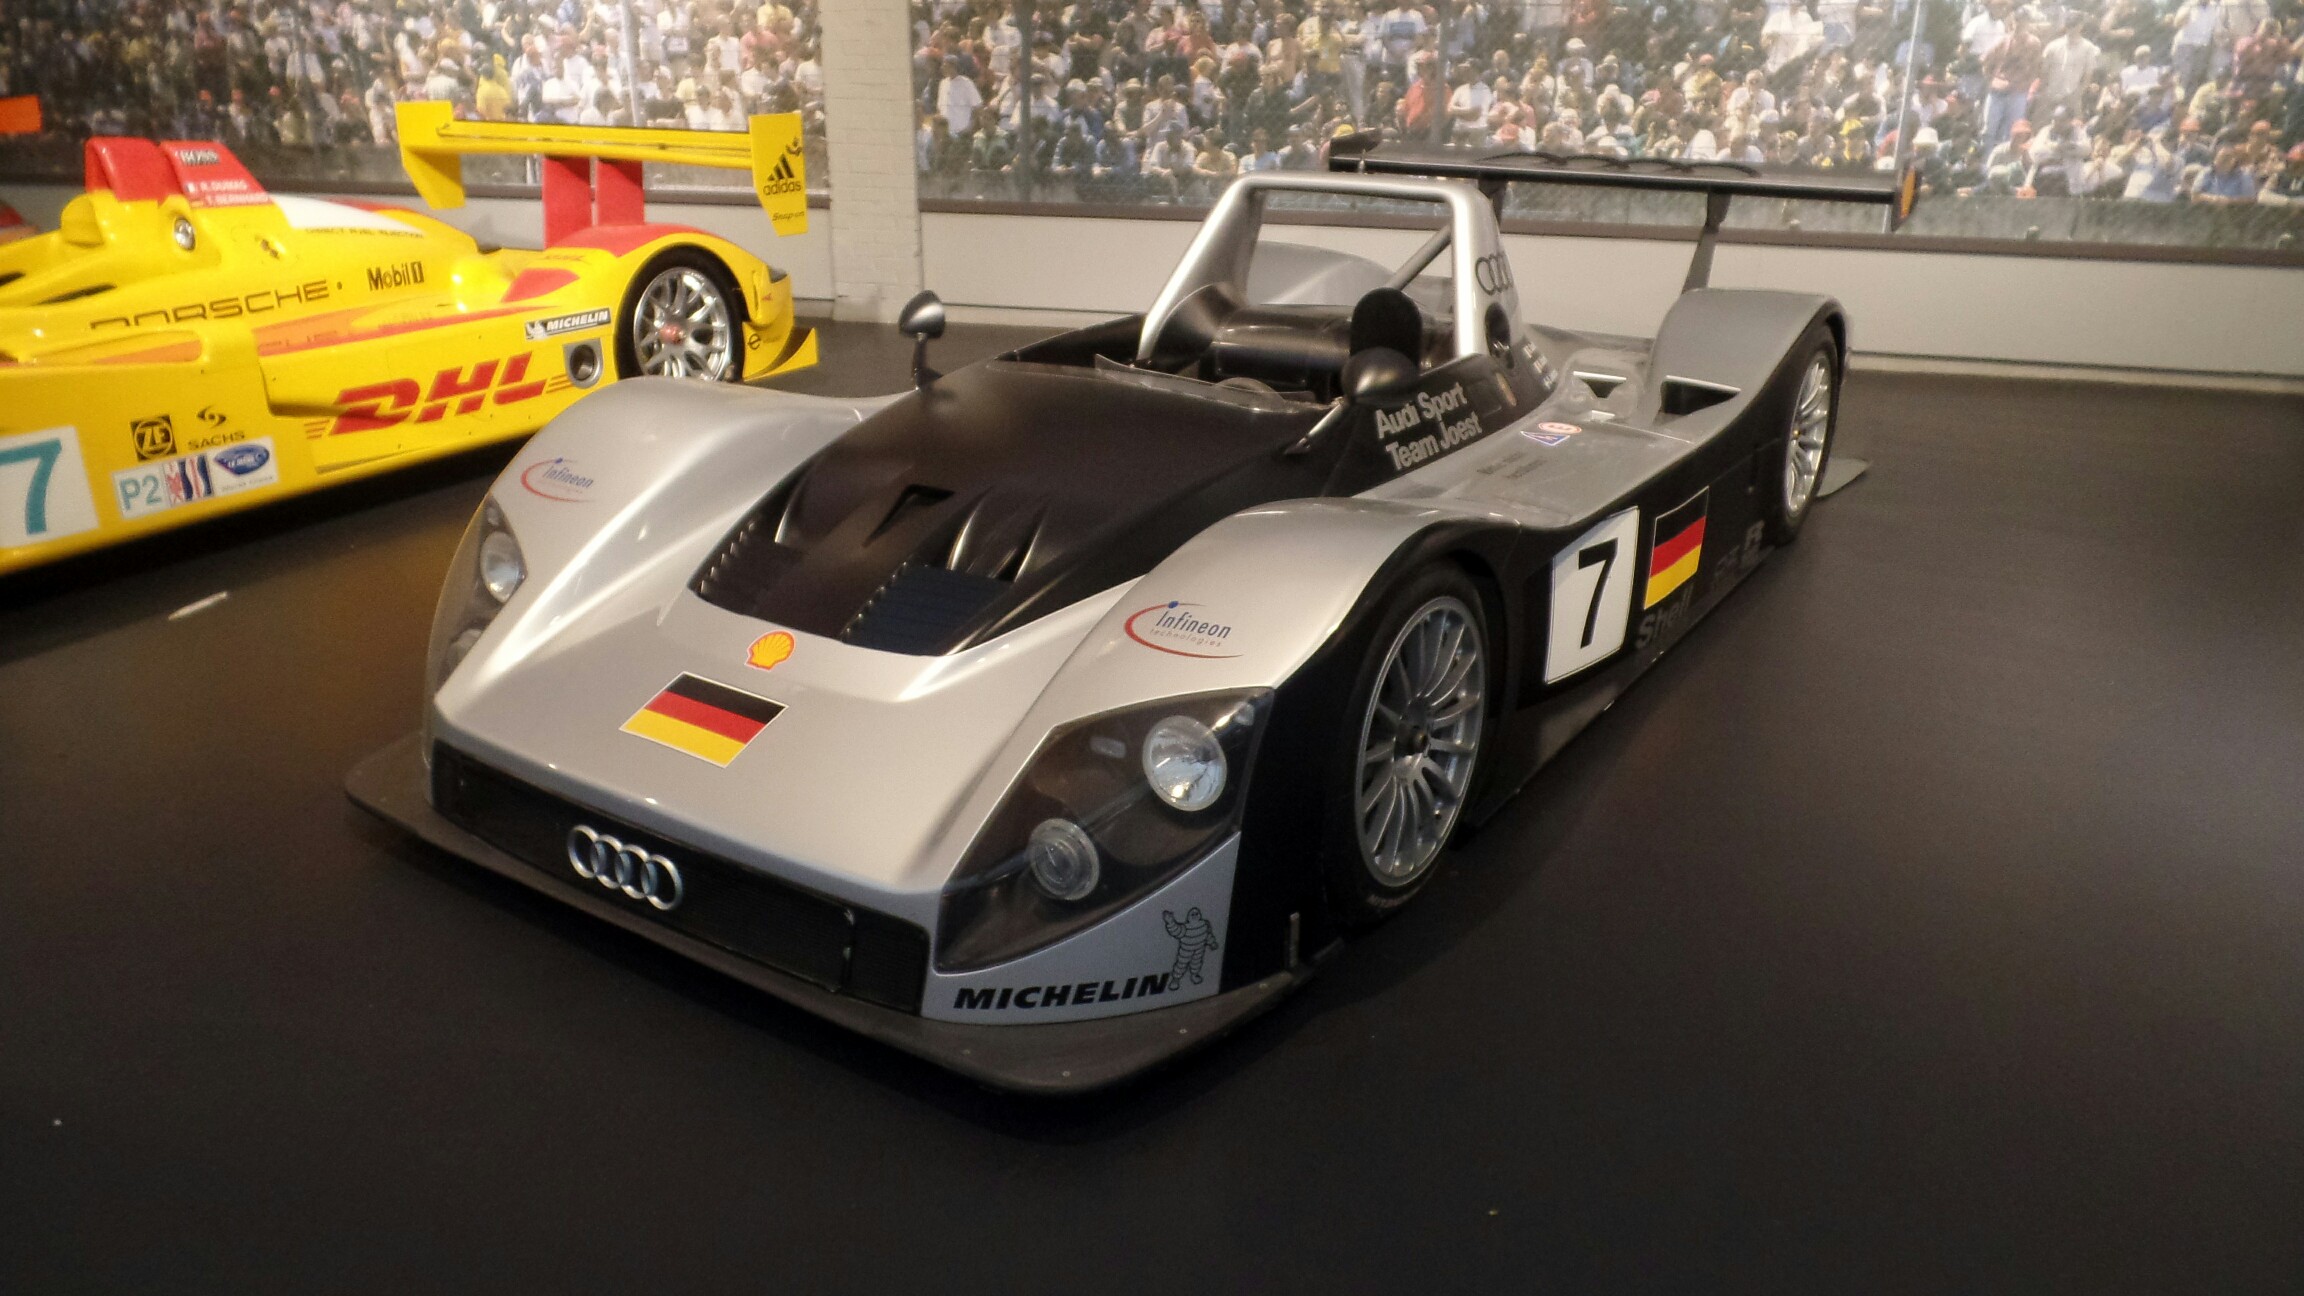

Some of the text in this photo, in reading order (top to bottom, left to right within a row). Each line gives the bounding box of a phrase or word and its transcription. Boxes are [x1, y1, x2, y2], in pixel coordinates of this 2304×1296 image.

[763, 180, 802, 196] adidas
[366, 262, 410, 291] Mobil
[546, 310, 609, 331] MICHELIN
[328, 351, 548, 436] DHL
[1375, 402, 1421, 439] Audi
[1417, 382, 1468, 421] Sport
[188, 430, 246, 450] SACHS
[1385, 434, 1440, 470] Team
[1439, 410, 1483, 449] Joest
[0, 438, 62, 535] 7
[119, 475, 161, 512] P2
[1578, 537, 1619, 650] 7
[1155, 610, 1232, 639] Infineon
[1635, 582, 1695, 650] Shell
[953, 972, 1170, 1010] MICHELIN
